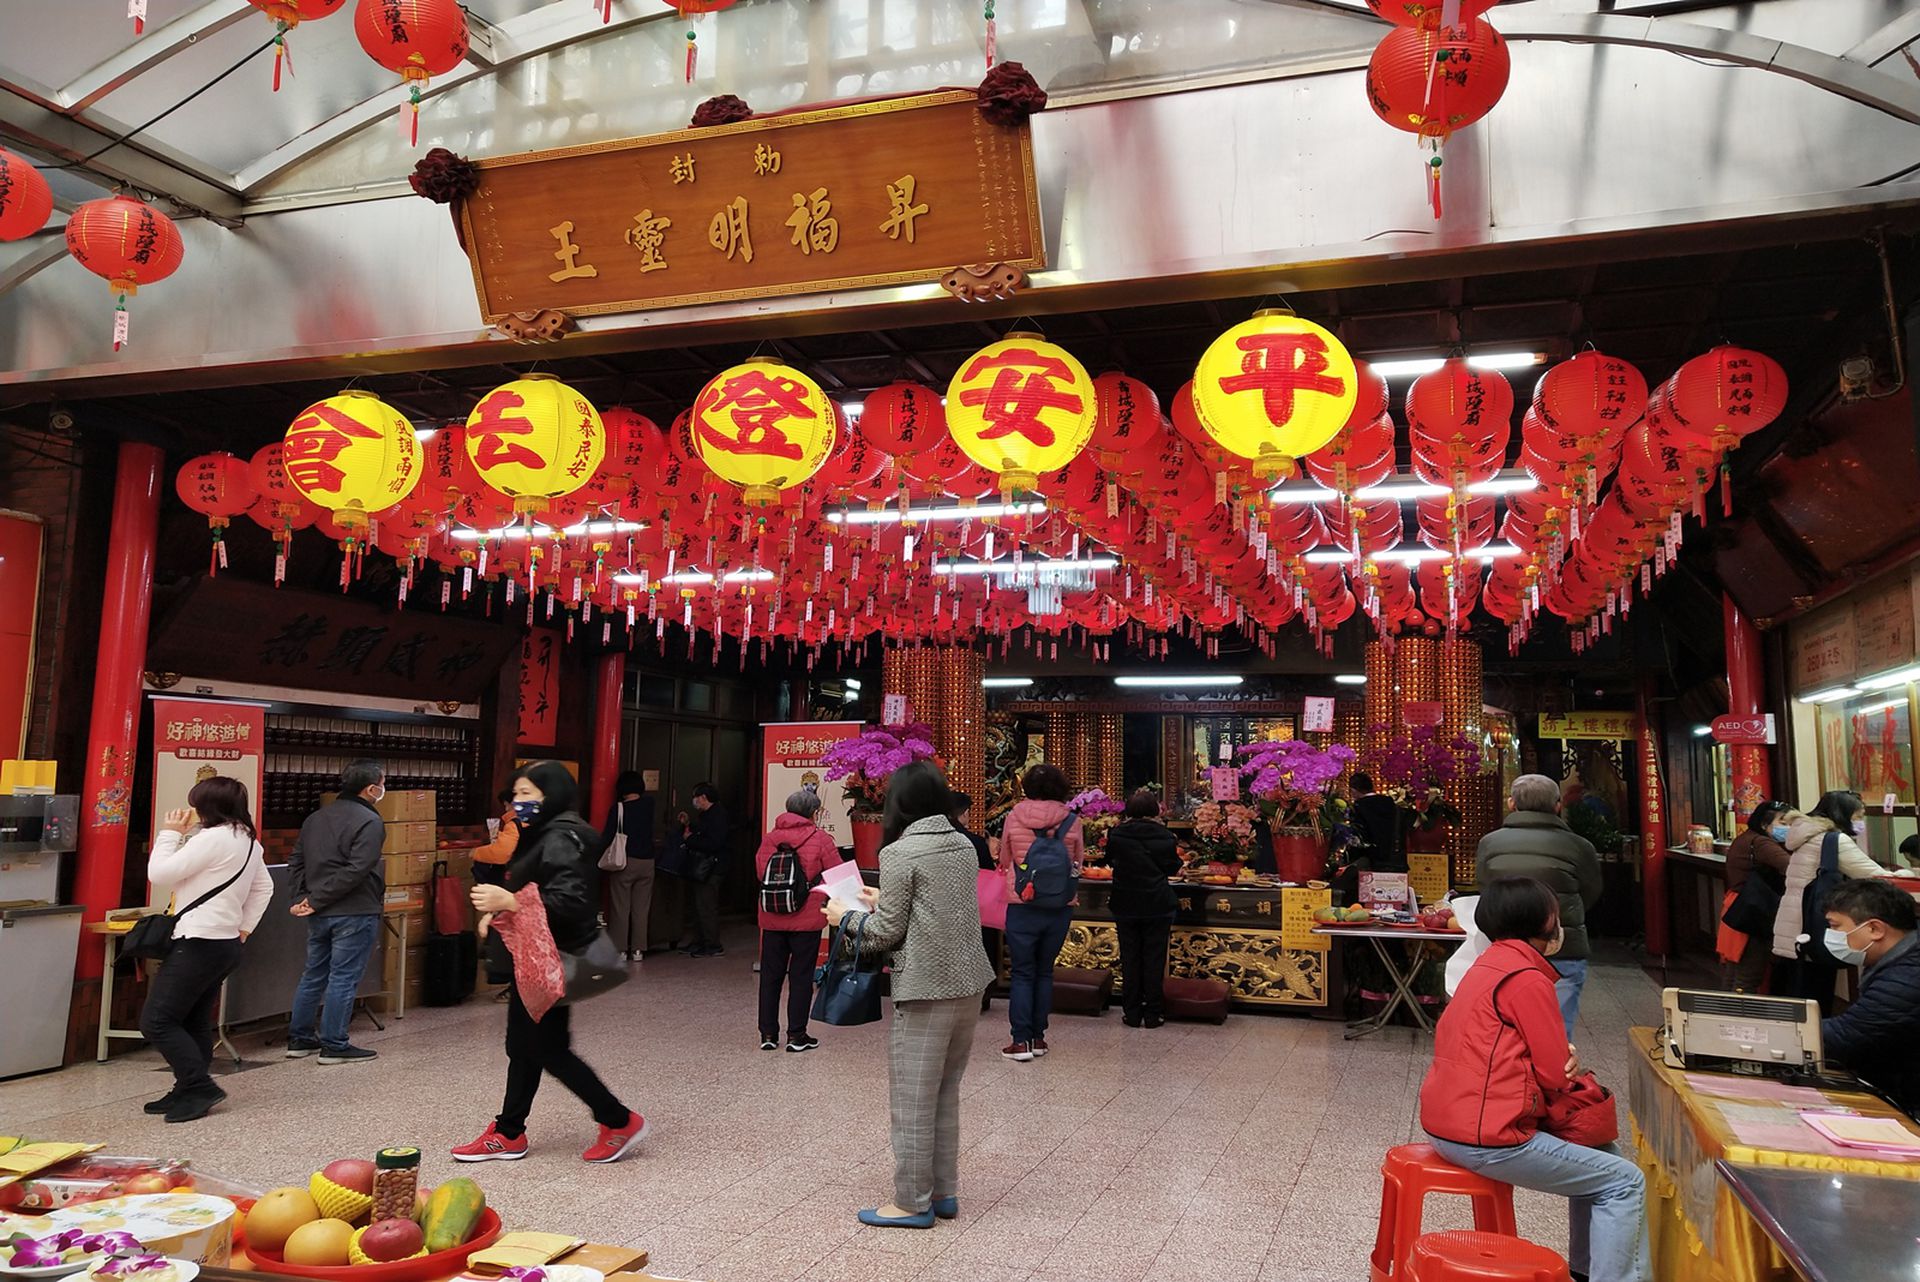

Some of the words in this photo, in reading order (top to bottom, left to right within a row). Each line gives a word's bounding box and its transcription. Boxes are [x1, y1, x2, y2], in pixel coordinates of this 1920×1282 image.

[959, 348, 1083, 447] 安
[1218, 333, 1346, 427] 平
[282, 402, 385, 494] 會
[1718, 721, 1741, 730] AED
